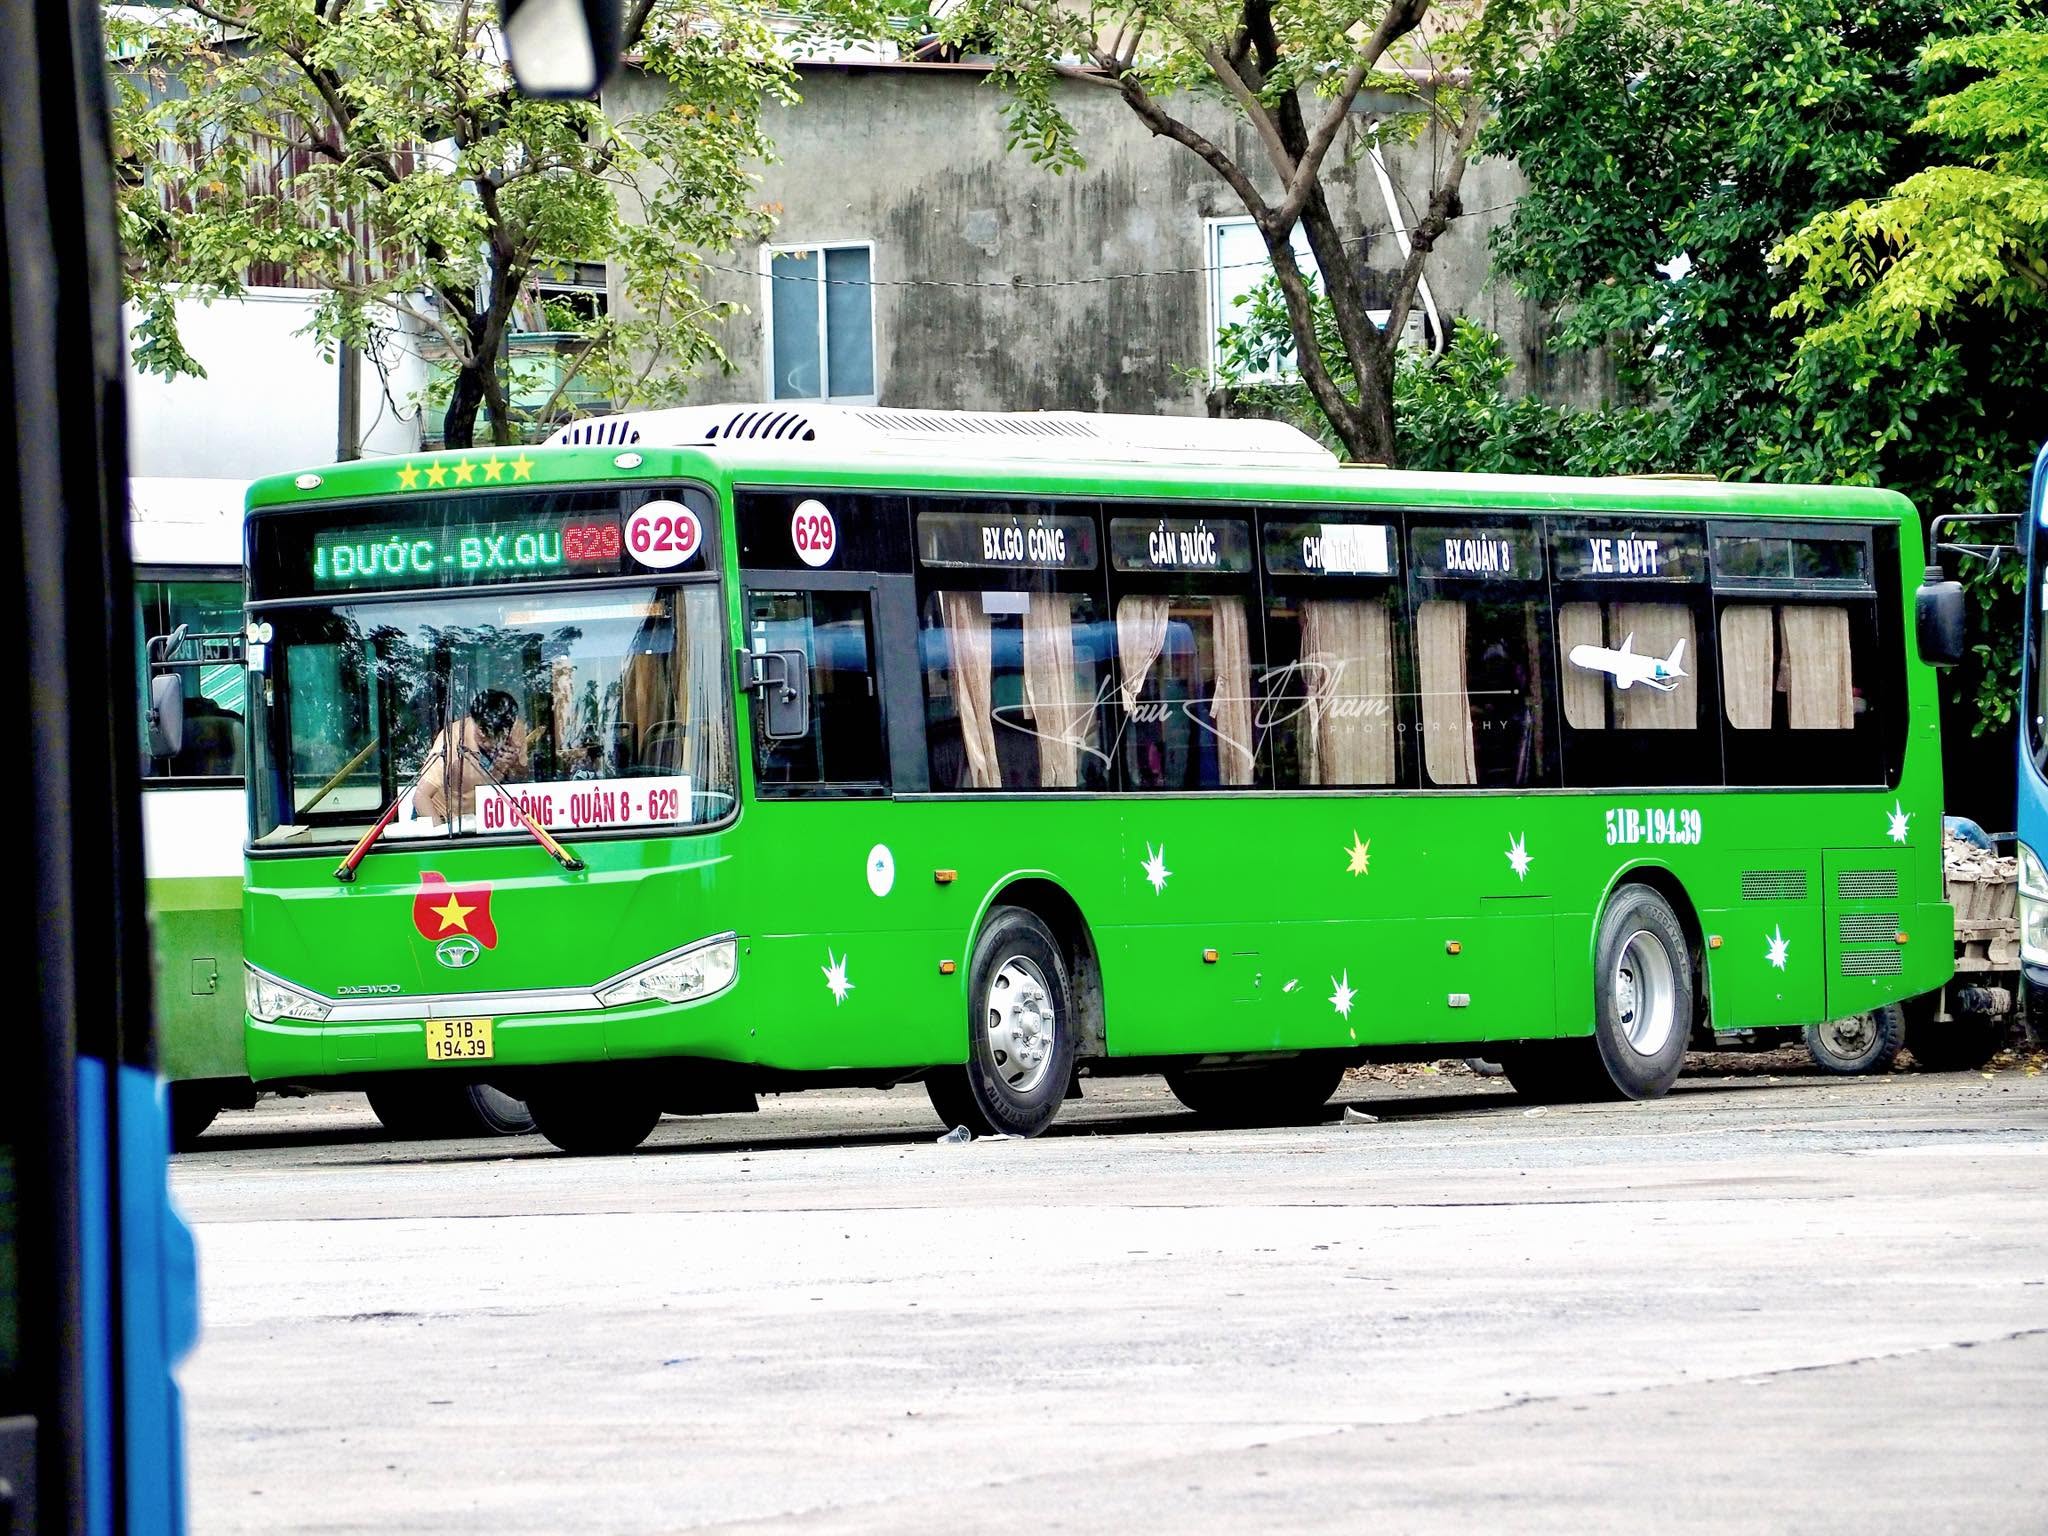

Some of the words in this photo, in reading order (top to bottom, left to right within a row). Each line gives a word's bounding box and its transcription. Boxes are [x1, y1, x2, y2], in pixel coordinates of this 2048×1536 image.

[564, 525, 620, 559] 629
[632, 516, 695, 552] 629
[796, 515, 833, 551] 629
[982, 517, 1024, 561] BX.GÒ
[1028, 519, 1066, 561] CÔNG
[1149, 520, 1177, 564] CẦN
[1180, 520, 1217, 564] ĐƯỚC
[1445, 533, 1499, 578] BX.QUẬN
[1501, 541, 1510, 571] 8
[1590, 538, 1613, 573] XE
[1617, 532, 1658, 574] BÚYT
[620, 791, 630, 822] 8
[648, 788, 679, 820] 629
[1606, 808, 1702, 846] 51B-194.39
[337, 984, 400, 995] DAEWOO
[445, 1022, 473, 1038] 51B
[435, 1040, 486, 1057] 194.39
